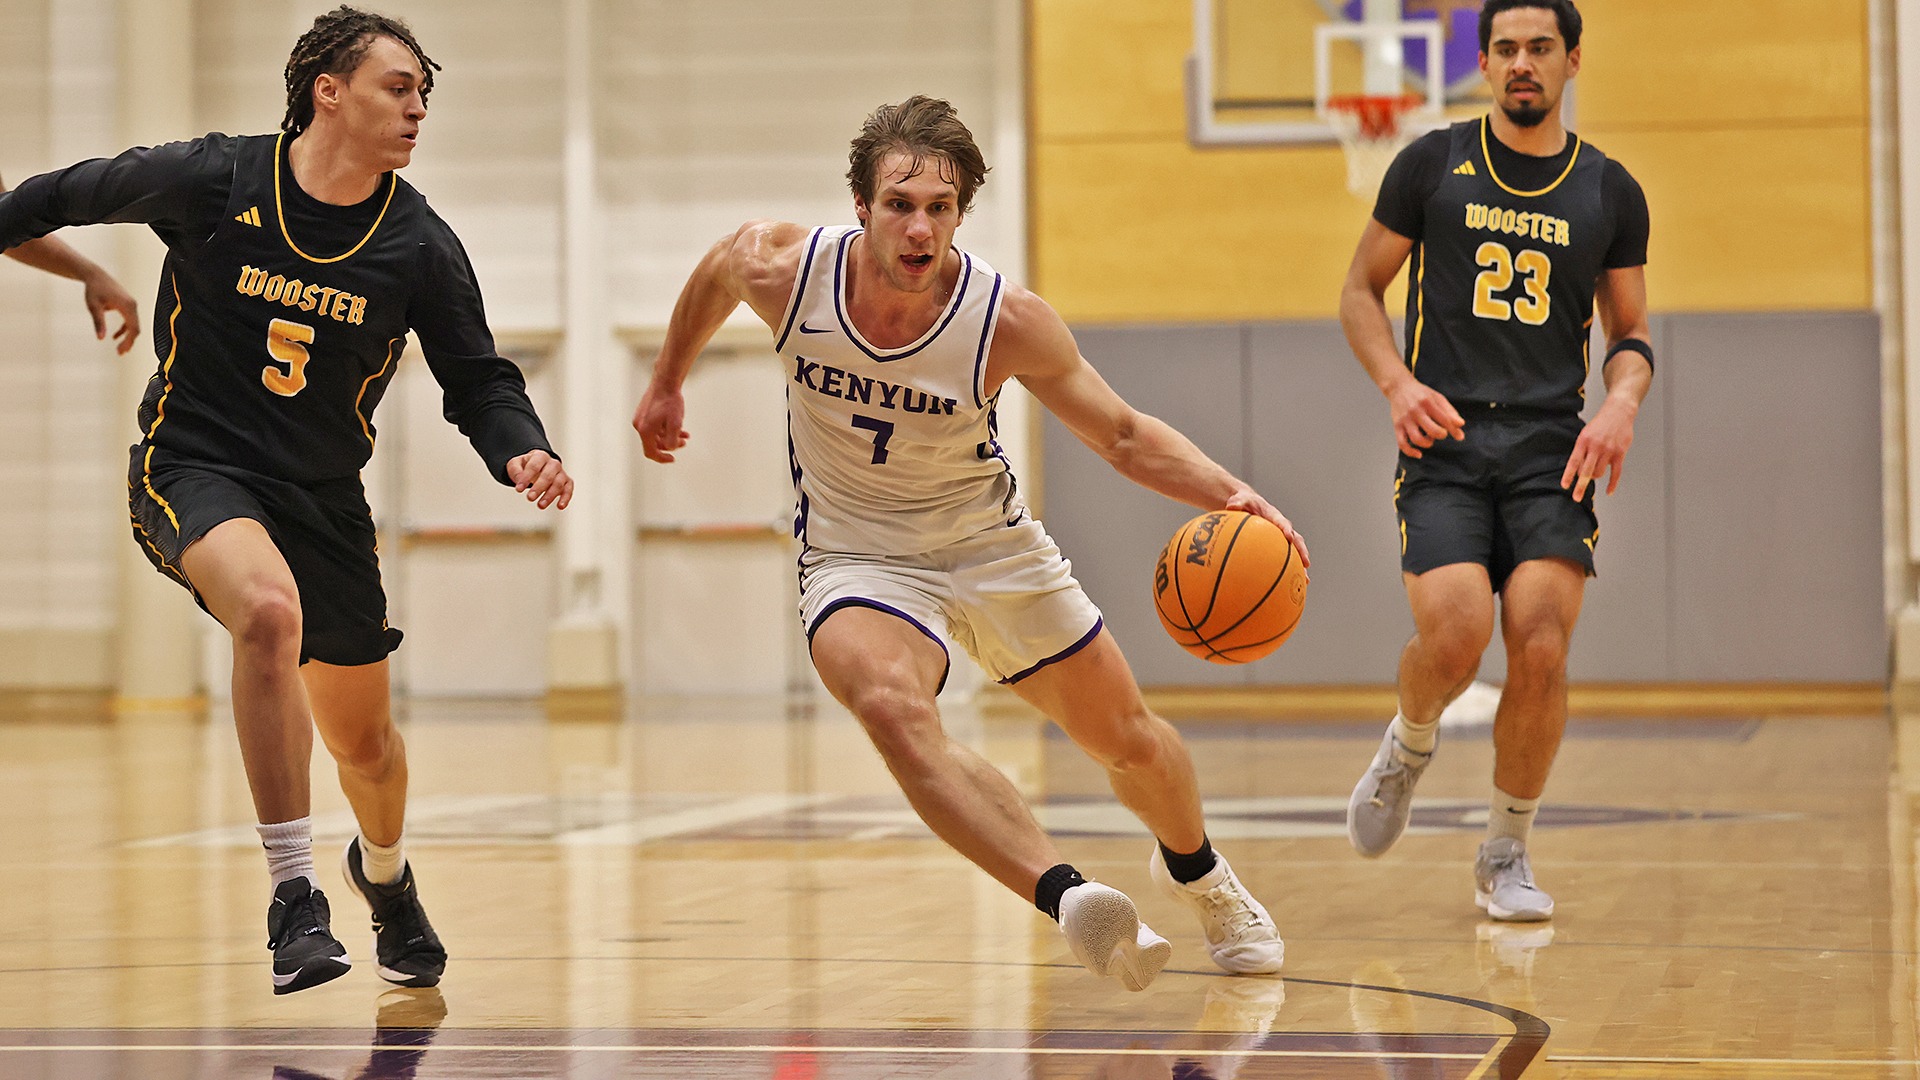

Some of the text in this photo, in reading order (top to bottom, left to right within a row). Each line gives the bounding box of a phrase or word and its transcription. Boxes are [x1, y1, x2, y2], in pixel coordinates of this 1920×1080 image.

[1465, 202, 1570, 247] WOOSTER
[236, 264, 367, 326] WOOSTER
[1472, 241, 1552, 326] 23
[261, 317, 315, 397] 5
[794, 355, 957, 415] KENYON
[851, 413, 894, 464] 7
[1186, 513, 1227, 566] NCAA
